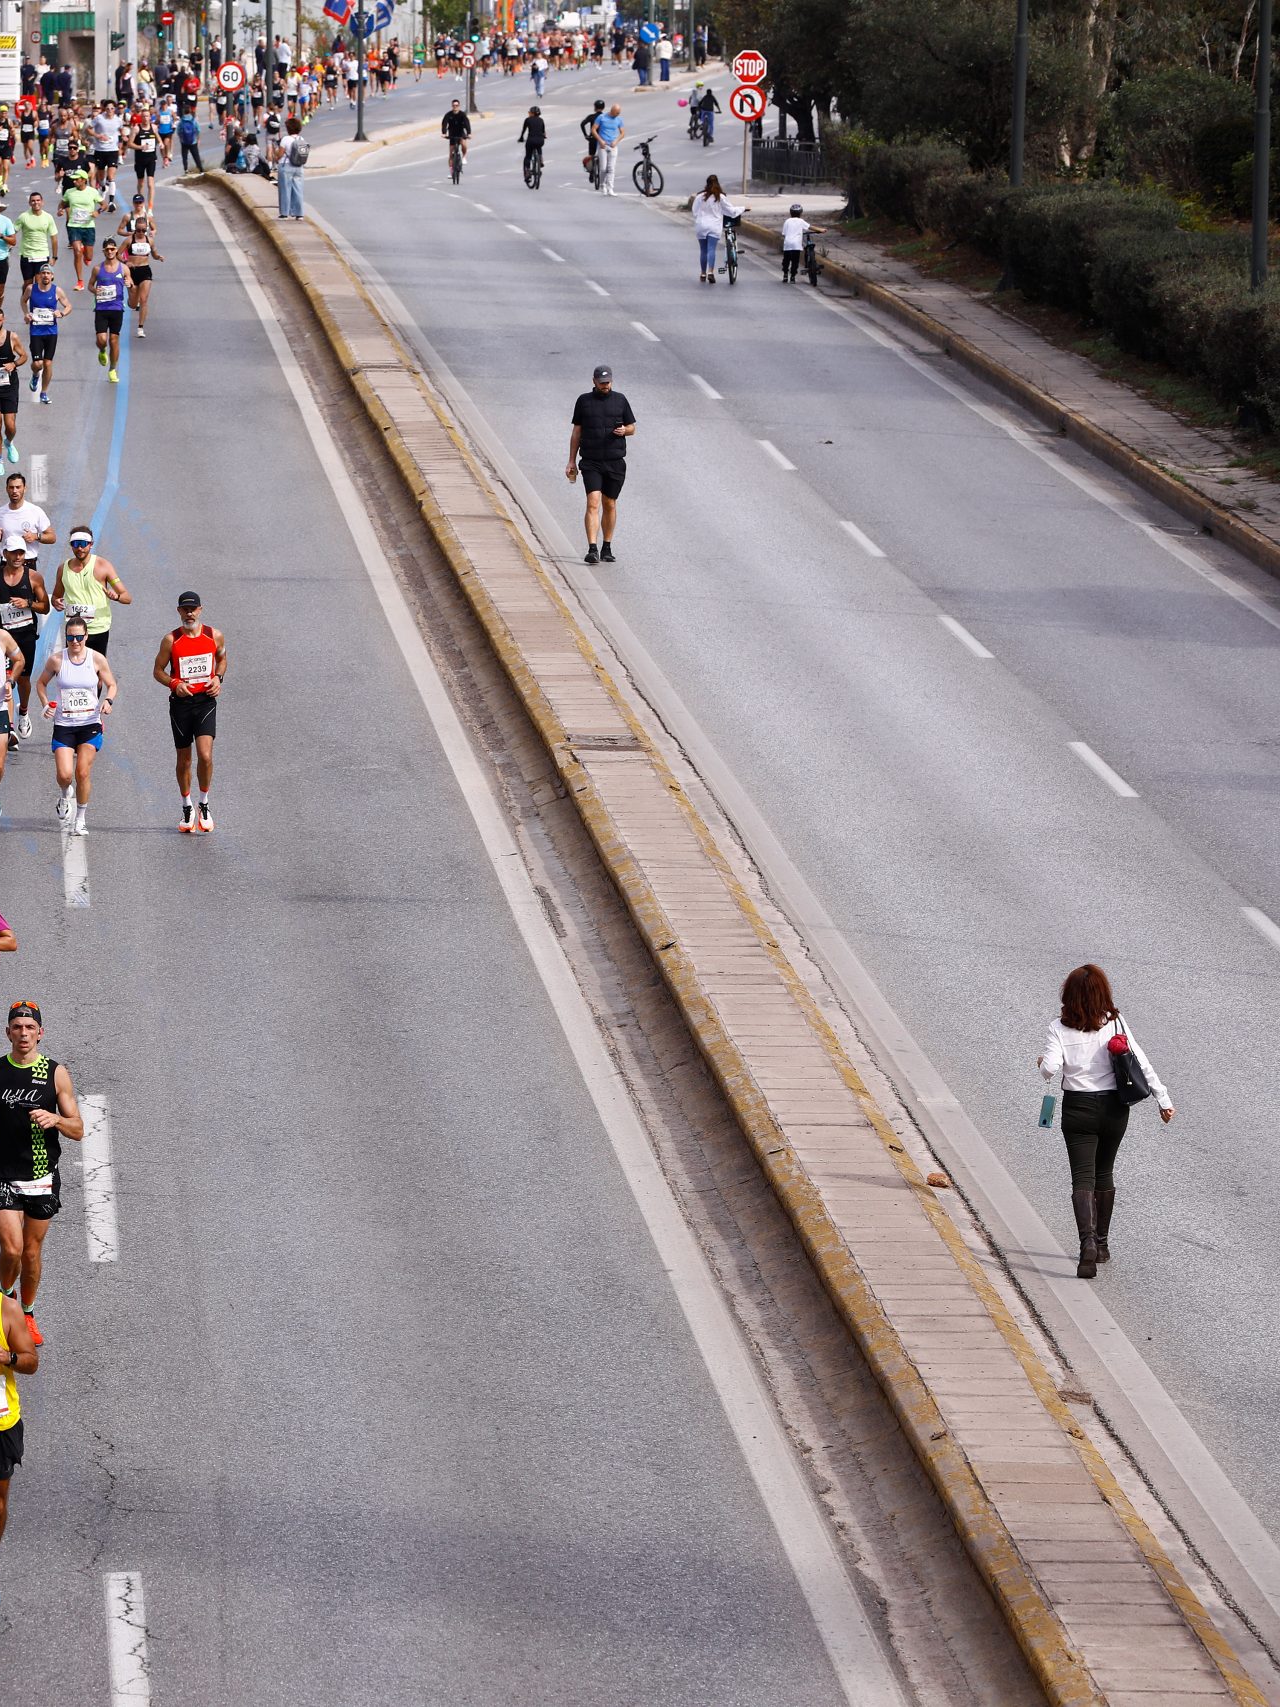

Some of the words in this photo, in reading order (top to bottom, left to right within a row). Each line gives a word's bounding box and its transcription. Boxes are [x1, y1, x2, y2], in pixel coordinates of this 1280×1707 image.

[735, 59, 763, 76] STOP
[223, 71, 238, 81] 60
[72, 605, 88, 613] 1662
[8, 610, 25, 619] 1701
[188, 665, 207, 673] 2239
